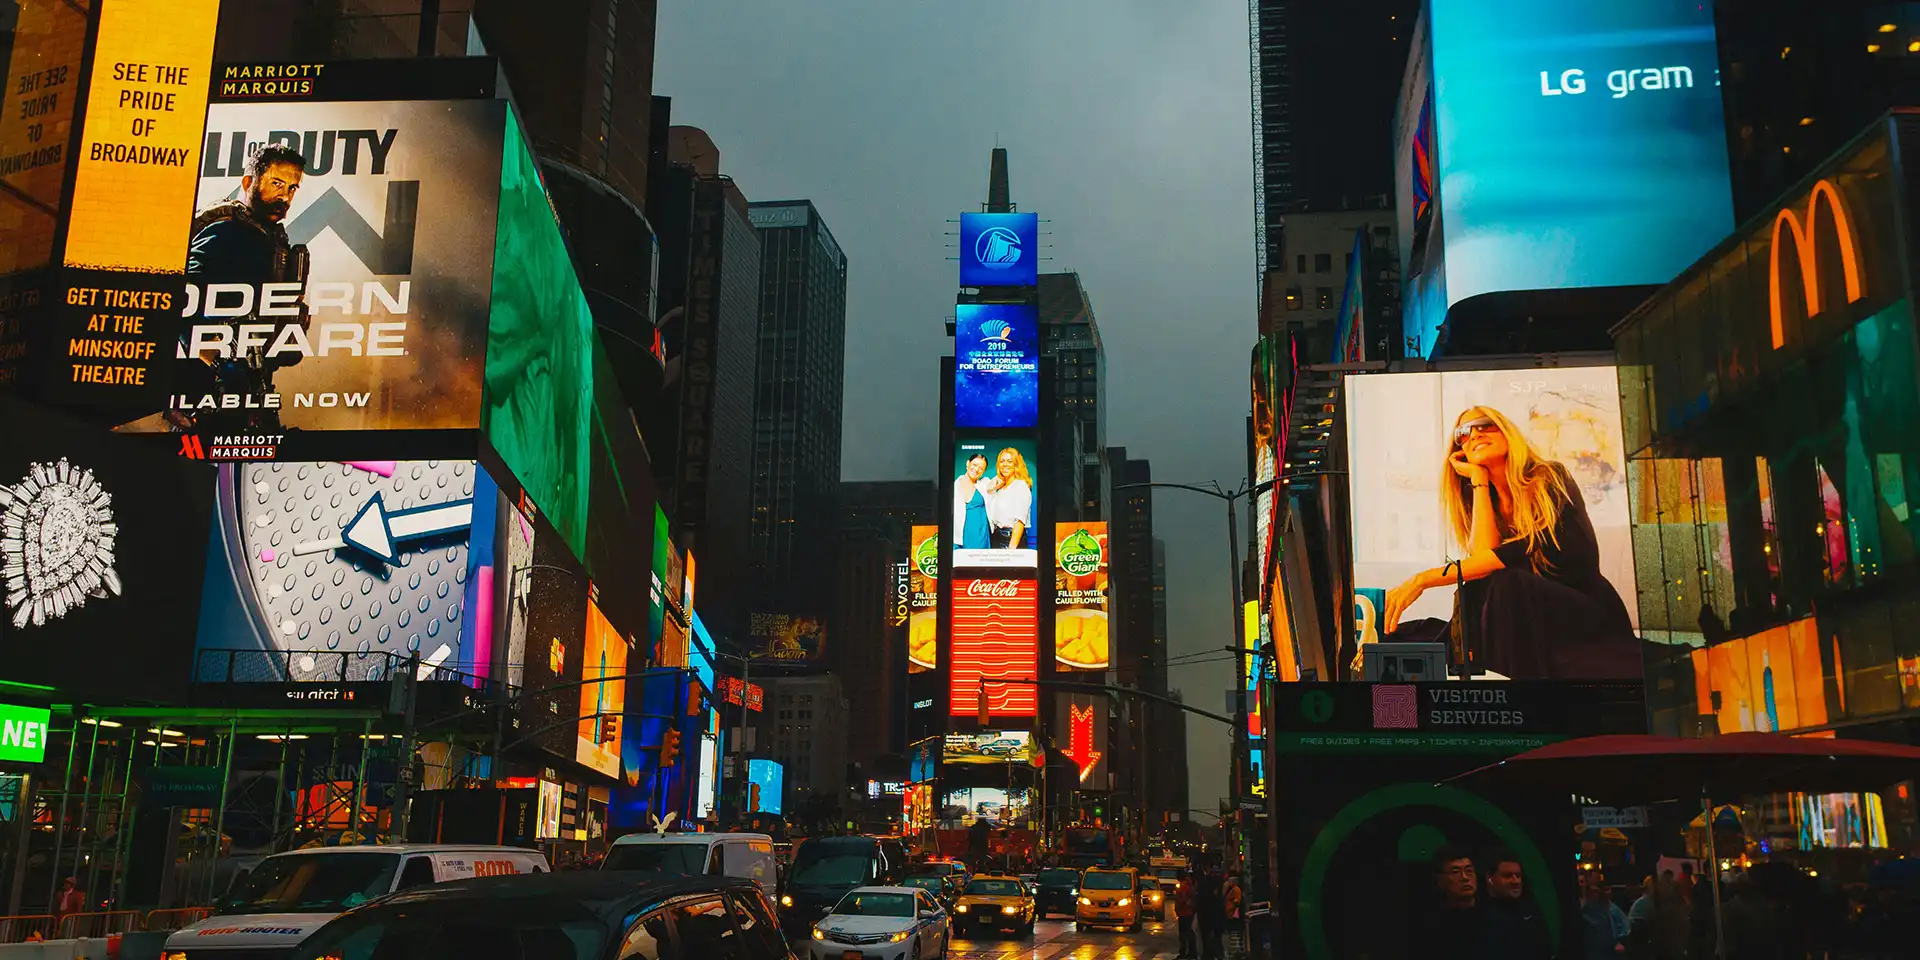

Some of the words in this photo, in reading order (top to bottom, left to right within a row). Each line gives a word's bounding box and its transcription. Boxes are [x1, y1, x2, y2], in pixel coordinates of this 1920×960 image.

[113, 62, 148, 83] SEE
[155, 66, 189, 86] THE
[224, 64, 324, 79] MARRIOTT
[223, 81, 311, 95] MARQUIS
[1541, 69, 1586, 96] LG
[1607, 65, 1693, 98] gram
[119, 90, 176, 112] PRIDE
[131, 118, 156, 138] OF
[90, 142, 189, 168] BROADWAY
[67, 287, 99, 306] GET
[103, 289, 172, 311] TICKETS
[87, 314, 109, 332] AT
[114, 316, 144, 334] THE
[176, 322, 407, 358] RFARE
[987, 342, 1007, 350] 2019
[69, 338, 156, 361] MINSKOFF
[72, 364, 146, 386] THEATRE
[294, 392, 371, 408] NOW
[213, 435, 283, 445] MARRIOTT
[212, 447, 273, 458] MARQUIS
[1064, 552, 1099, 564] Green
[1068, 562, 1101, 573] Giant
[896, 558, 910, 627] NOVOTEL
[967, 579, 1020, 597] Coca-Cola
[1058, 590, 1082, 598] FILLED
[1084, 589, 1103, 597] WITH
[1055, 597, 1106, 605] CAULIFLOWER
[1428, 689, 1508, 704] VISITOR
[1431, 710, 1525, 726] SERVICES
[1300, 737, 1323, 745] FREE
[1326, 737, 1360, 745] GUIDES
[1369, 737, 1392, 745] FREE
[1395, 737, 1420, 745] MAPS
[1429, 738, 1469, 746] TICKETS
[1479, 738, 1543, 747] INFORMATION
